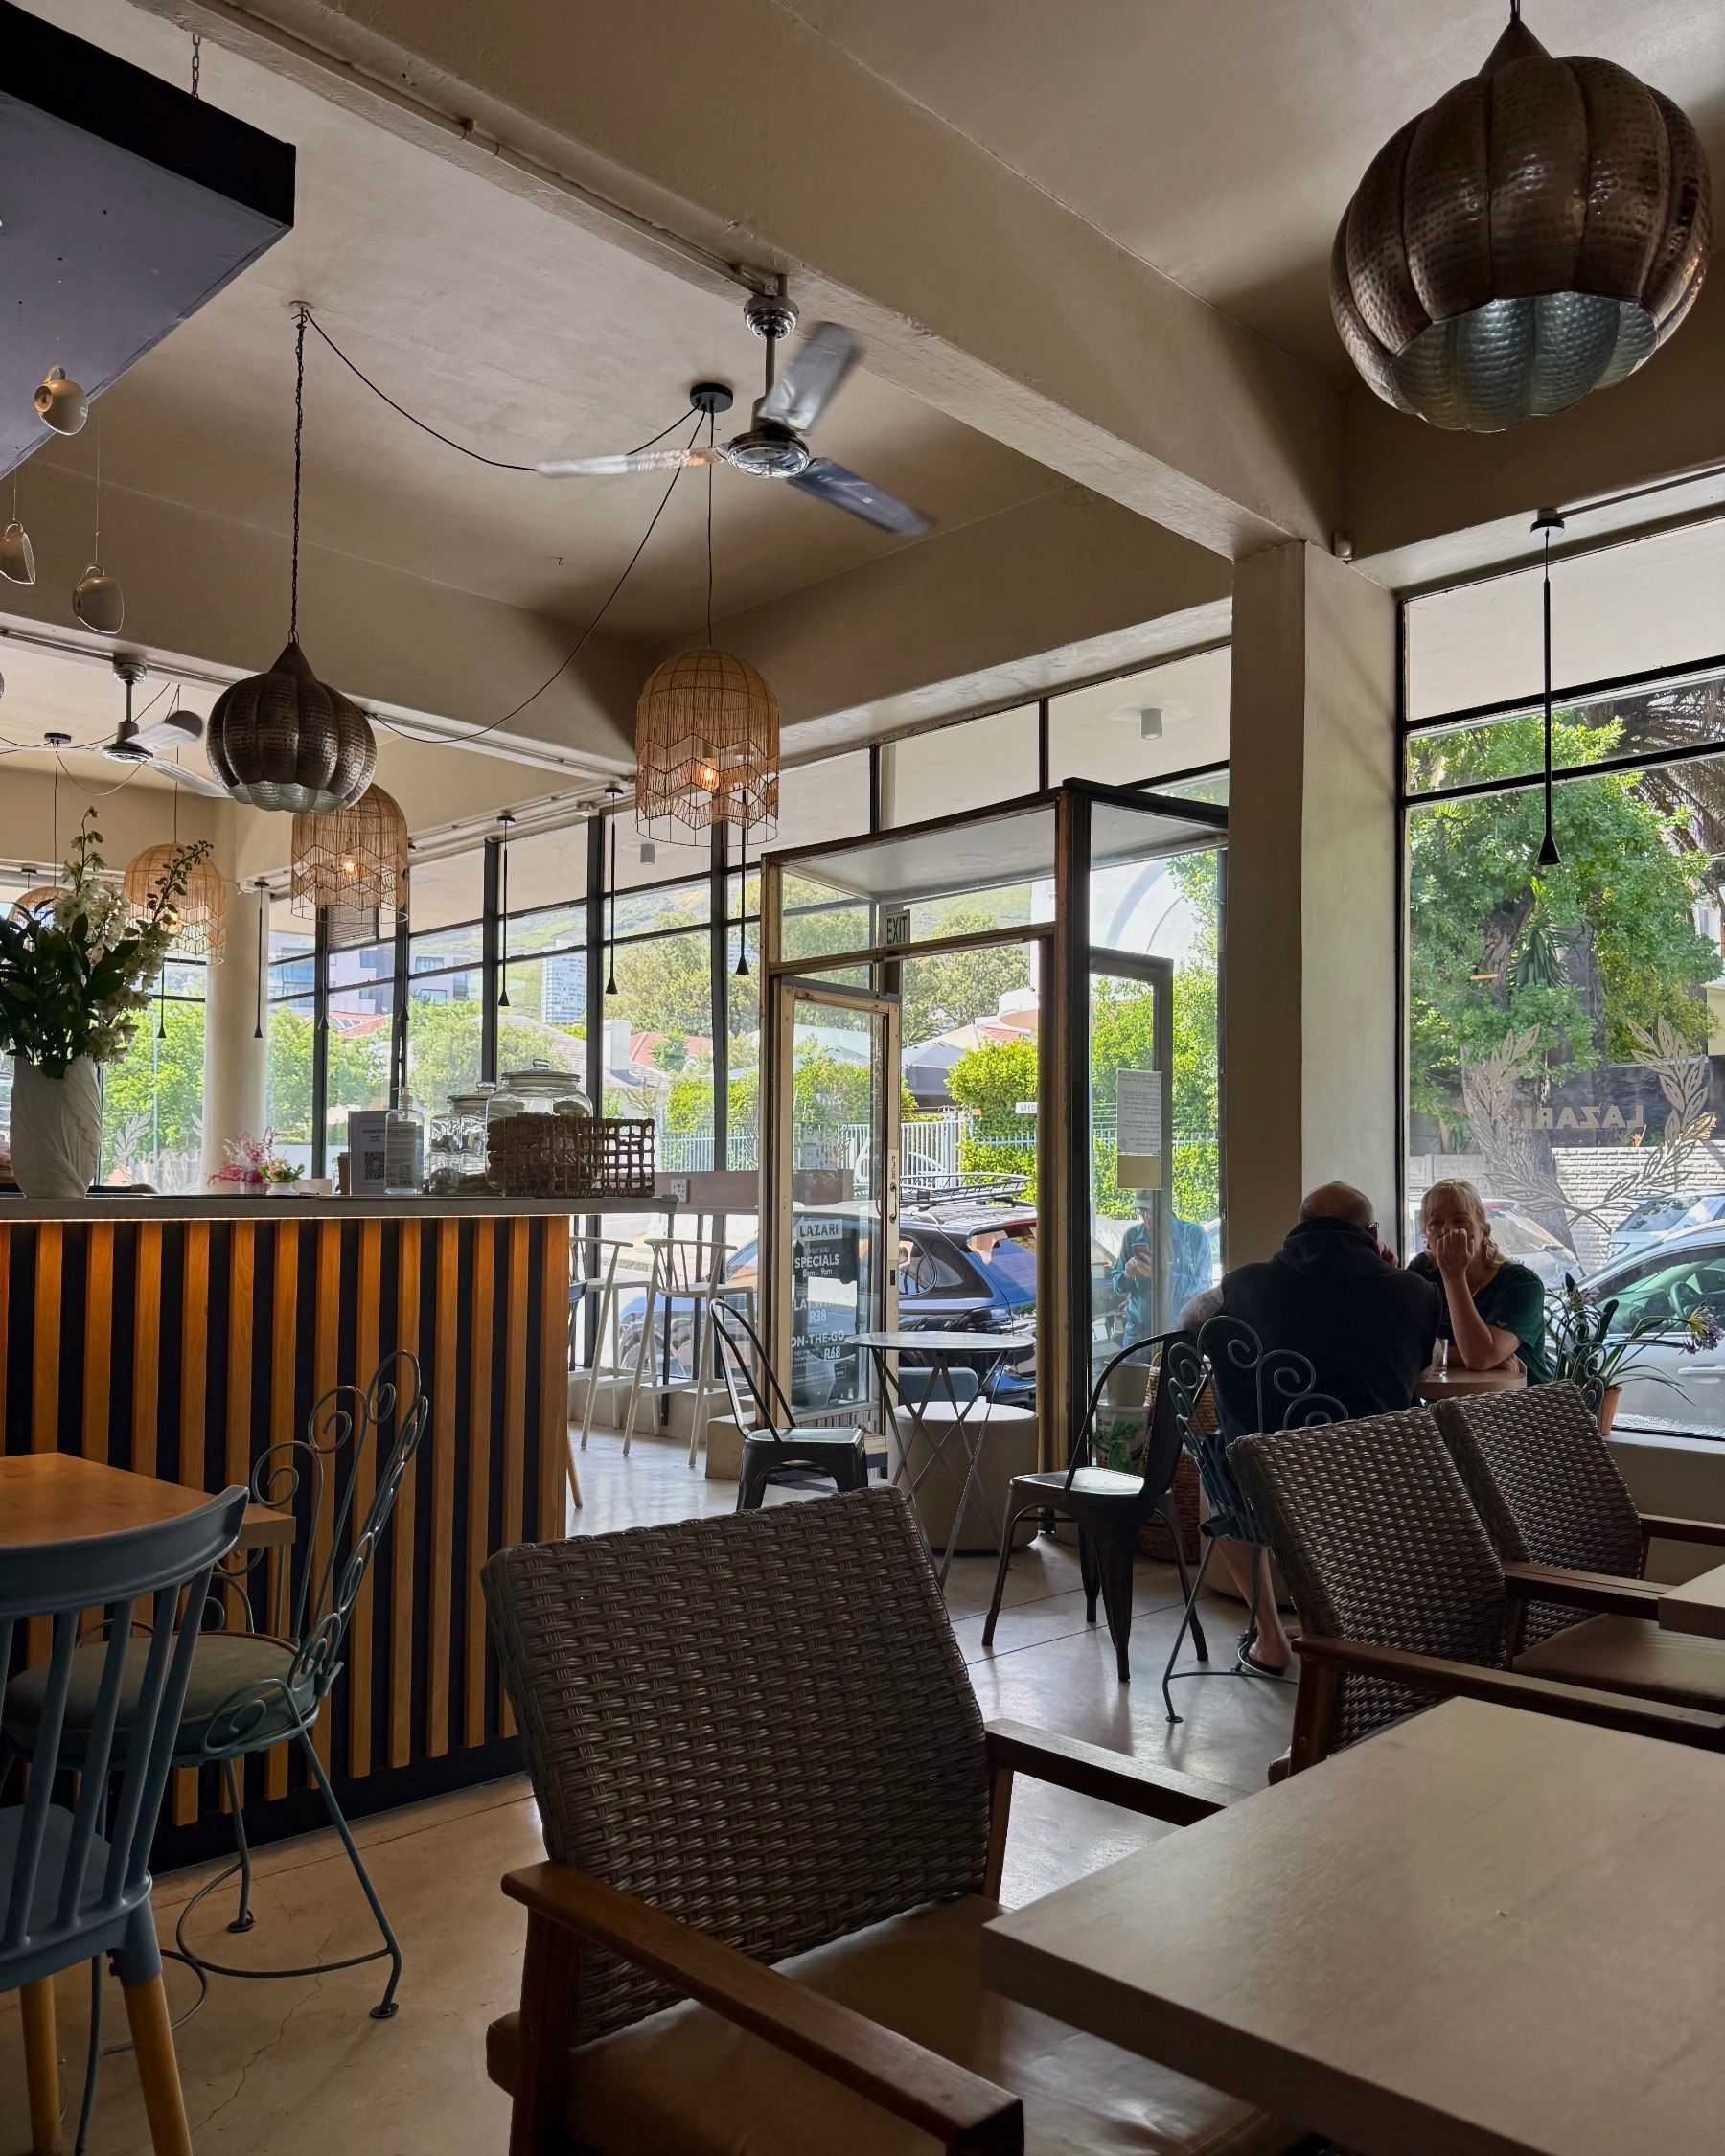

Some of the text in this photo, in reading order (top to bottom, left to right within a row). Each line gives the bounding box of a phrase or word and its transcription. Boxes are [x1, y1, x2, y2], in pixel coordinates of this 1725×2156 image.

[886, 915, 908, 945] EXIT
[799, 1224, 839, 1237] LAZARI
[794, 1254, 840, 1269] SPECIALS
[802, 1269, 816, 1277] 8am
[821, 1267, 833, 1275] 9am
[809, 1309, 827, 1323] R38
[791, 1330, 844, 1348] ON-THE-GO
[824, 1346, 841, 1360] R68
